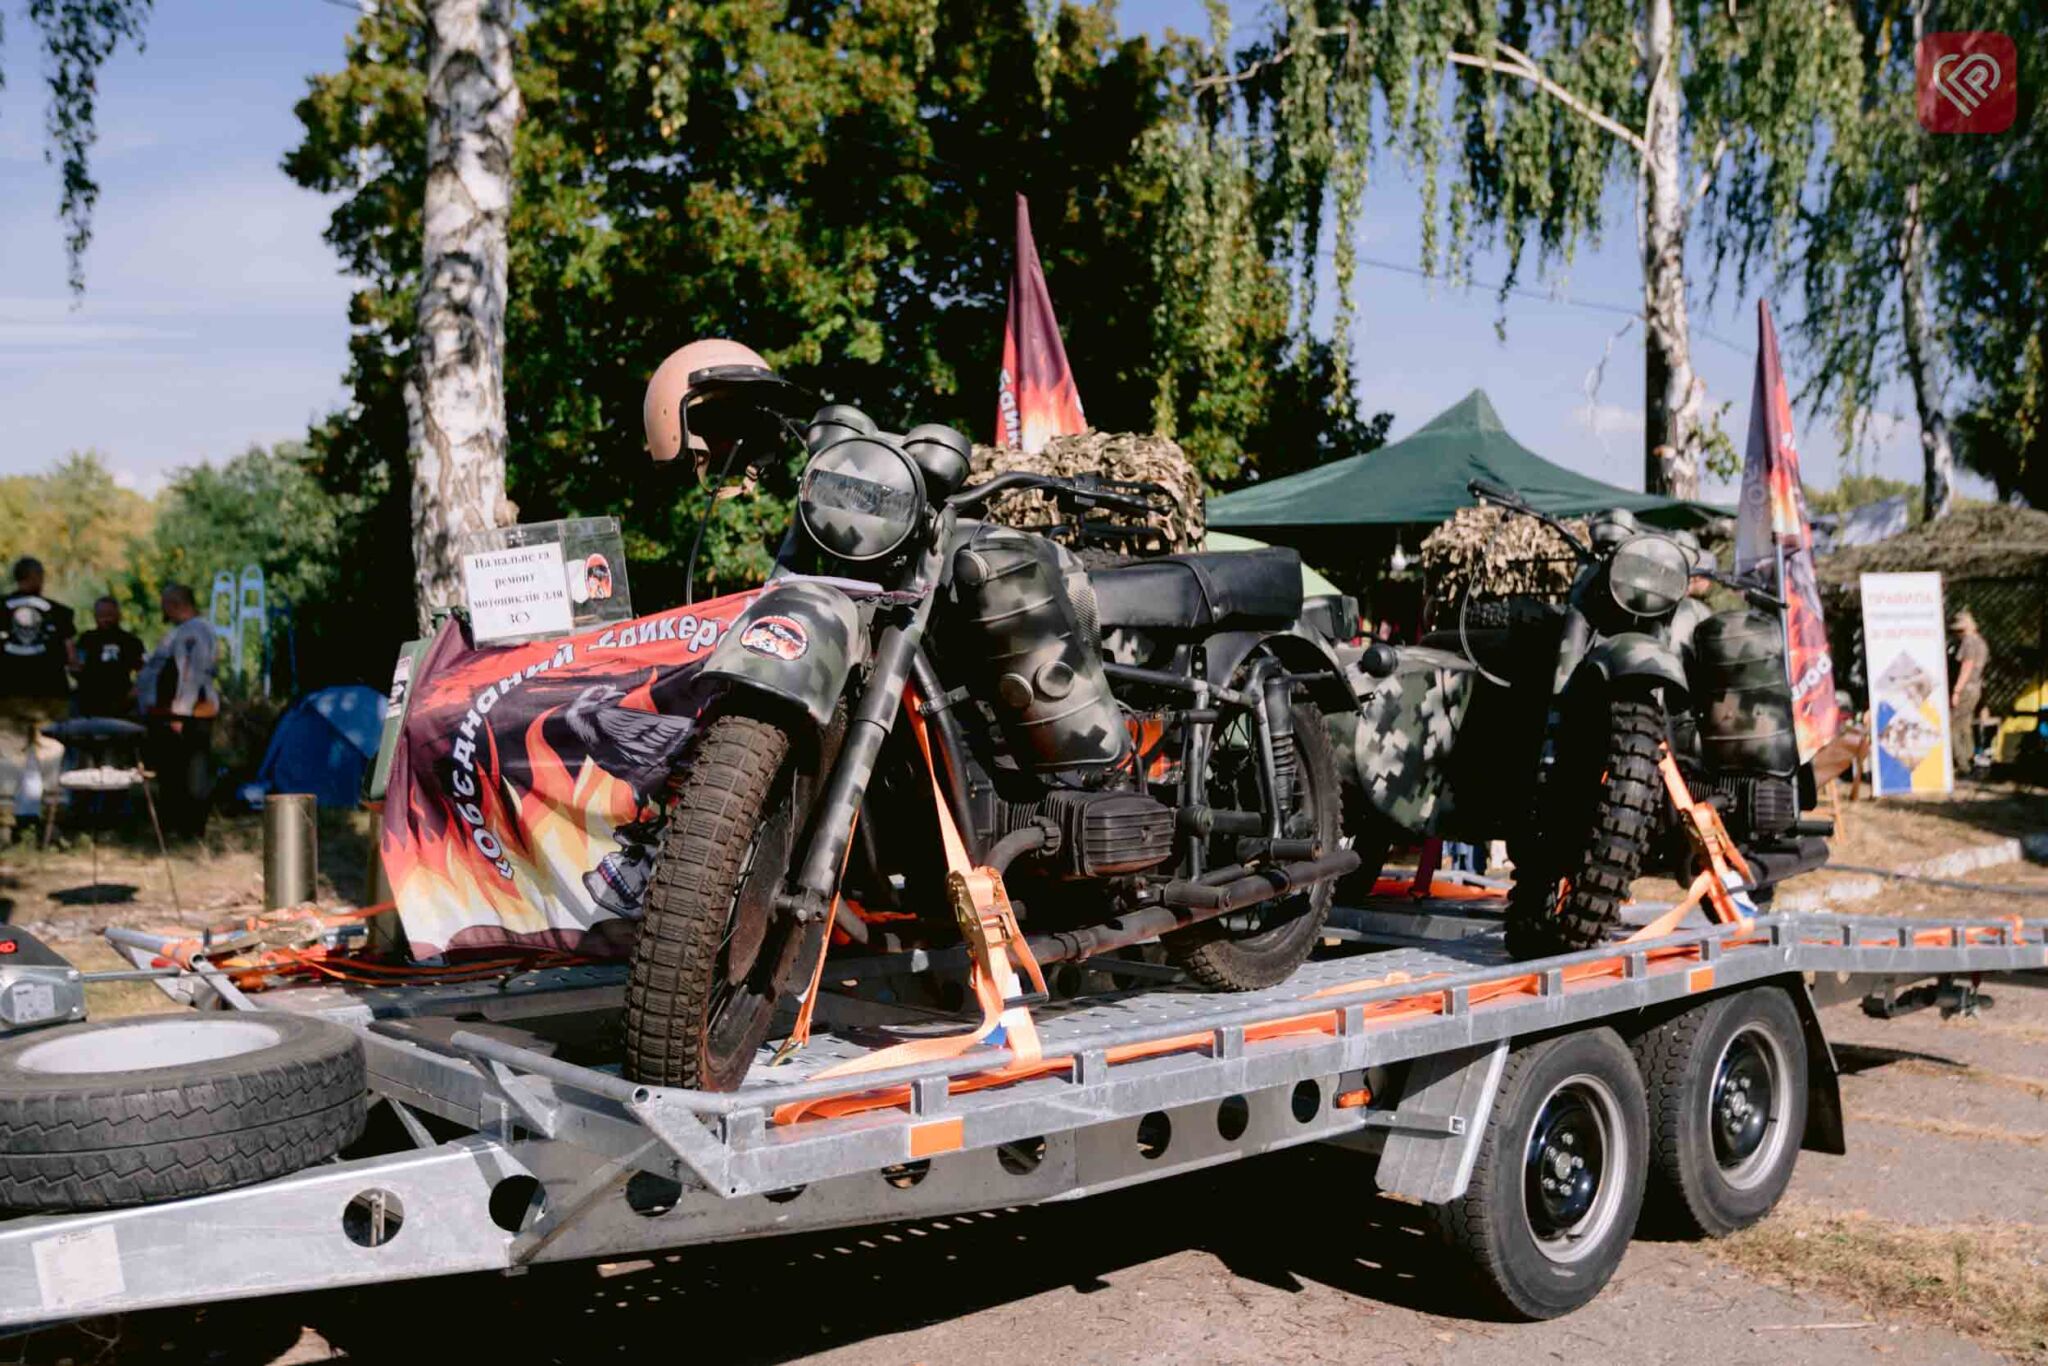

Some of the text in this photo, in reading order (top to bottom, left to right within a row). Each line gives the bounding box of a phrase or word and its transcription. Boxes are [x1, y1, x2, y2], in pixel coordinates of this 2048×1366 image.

[474, 557, 491, 569] На
[493, 554, 534, 569] пальне
[494, 573, 535, 590] ремонт
[543, 589, 563, 601] для
[510, 612, 531, 625] ЗСУ
